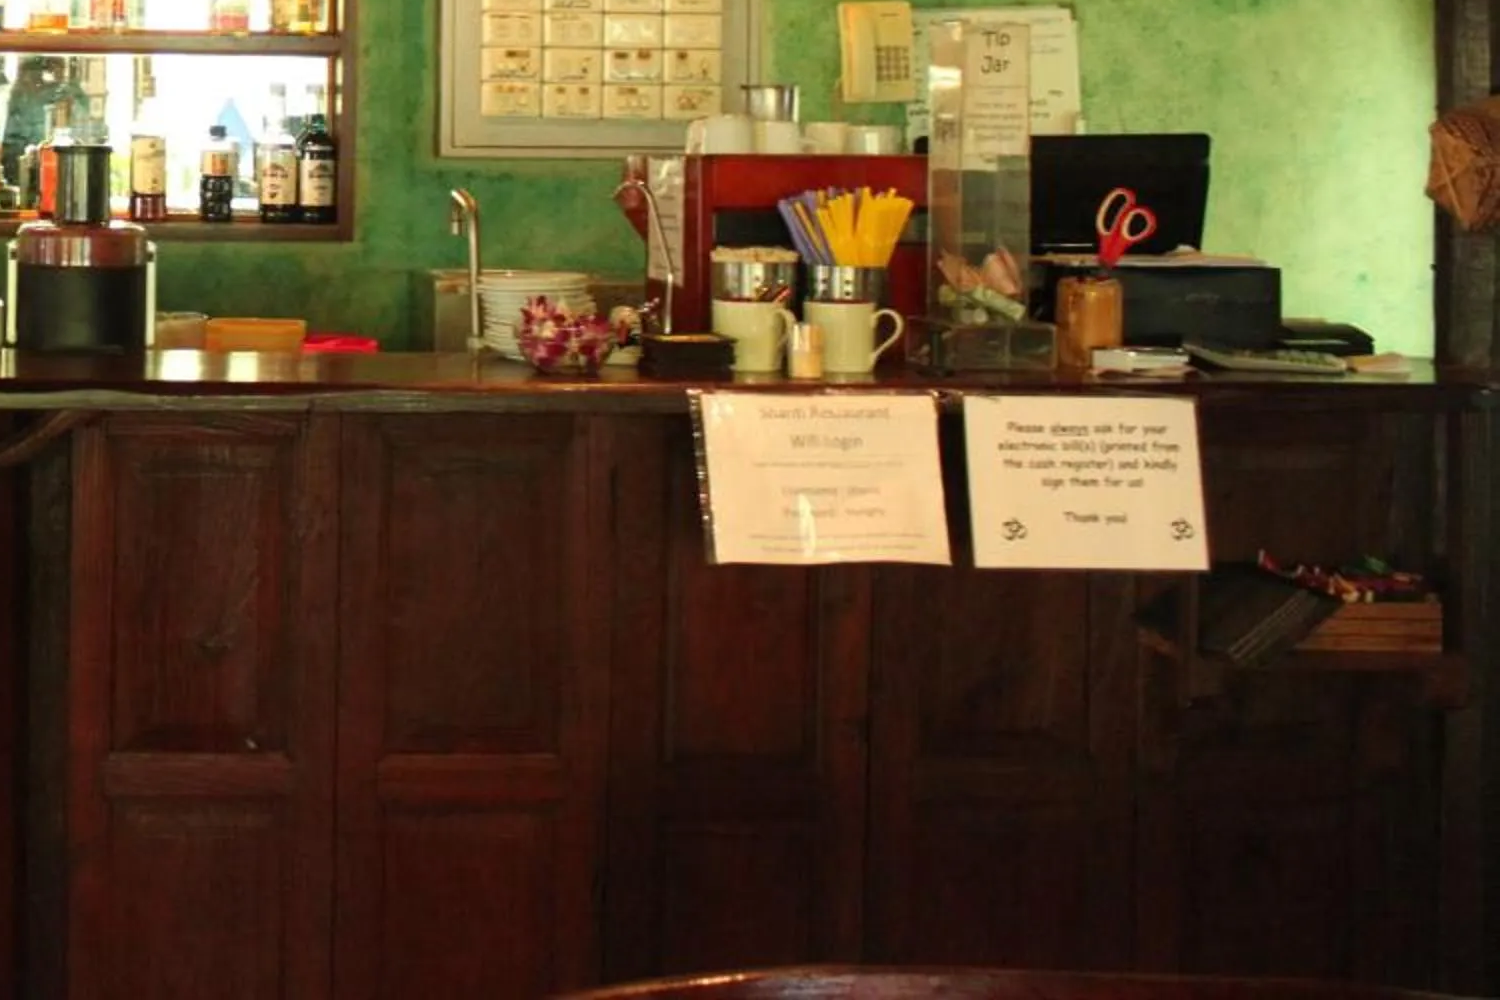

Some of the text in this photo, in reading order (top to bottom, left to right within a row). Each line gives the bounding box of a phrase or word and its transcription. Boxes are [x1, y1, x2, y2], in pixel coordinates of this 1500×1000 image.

[980, 55, 1011, 74] Jar
[1006, 420, 1045, 434] Please
[1050, 421, 1089, 437] always
[1118, 422, 1138, 434] for
[1142, 424, 1169, 438] your
[998, 441, 1056, 451] electronic
[1152, 440, 1180, 452] from
[1060, 459, 1114, 473] register)
[1118, 458, 1139, 470] and
[1144, 459, 1179, 472] kindly
[1104, 475, 1125, 487] for
[1063, 511, 1100, 523] Thank
